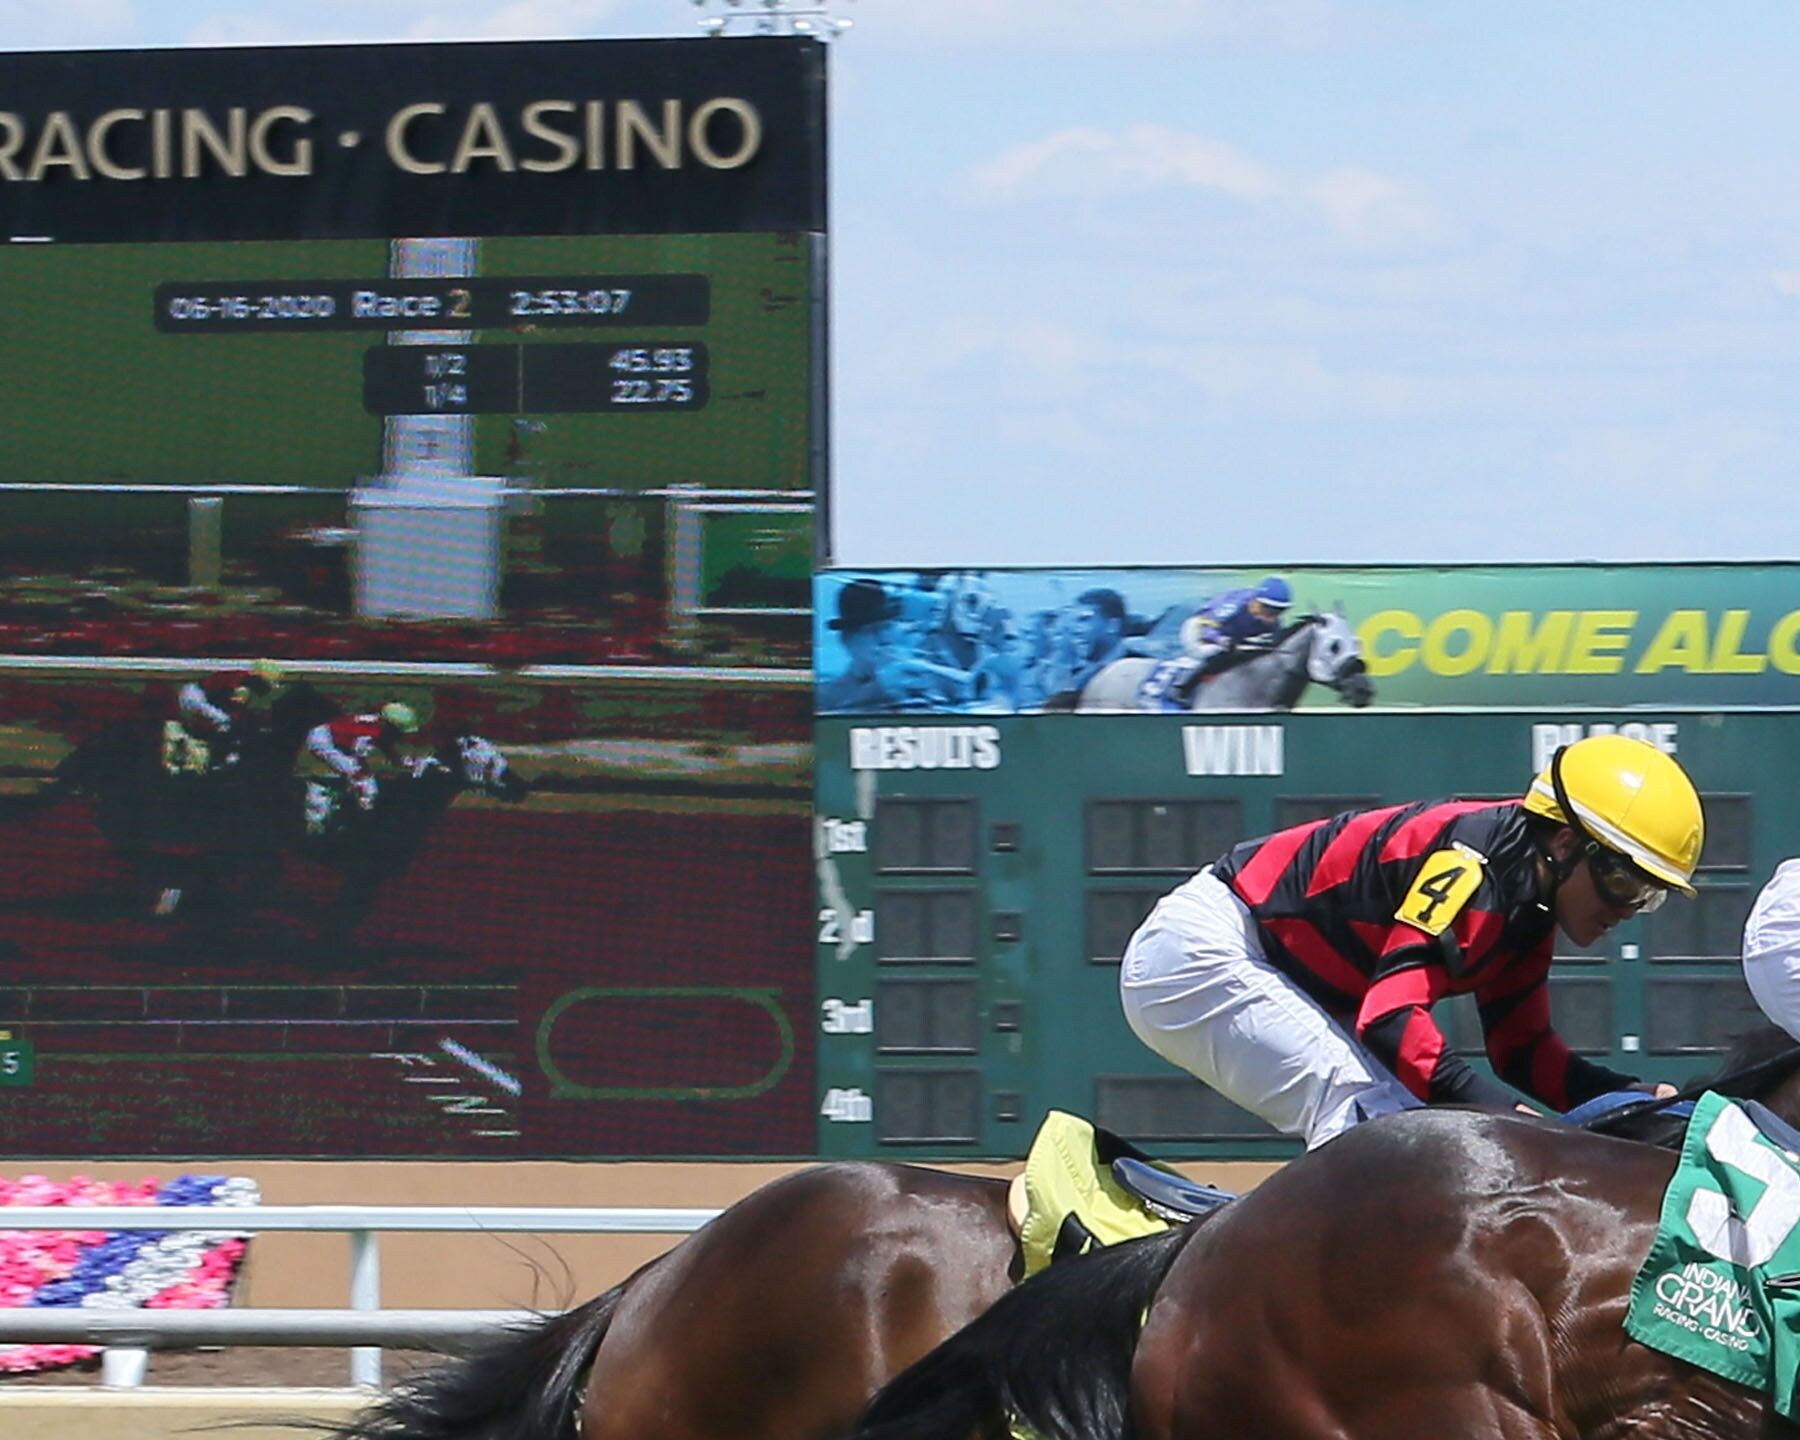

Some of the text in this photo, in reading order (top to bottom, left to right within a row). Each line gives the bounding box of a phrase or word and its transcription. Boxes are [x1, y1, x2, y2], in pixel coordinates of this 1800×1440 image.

[386, 98, 761, 175] CASINO
[352, 290, 442, 318] Race
[446, 288, 473, 318] 2
[1357, 609, 1639, 676] COME
[849, 726, 1001, 770] RESULTS
[1181, 725, 1284, 775] WIN
[822, 818, 868, 852] 1st
[1416, 865, 1467, 924] 4
[821, 999, 874, 1034] 3rd
[820, 1087, 873, 1122] 4th
[1655, 1271, 1761, 1338] GRAND
[1682, 1261, 1753, 1306] INDIANA
[1652, 1302, 1750, 1352] RACING CASINO
